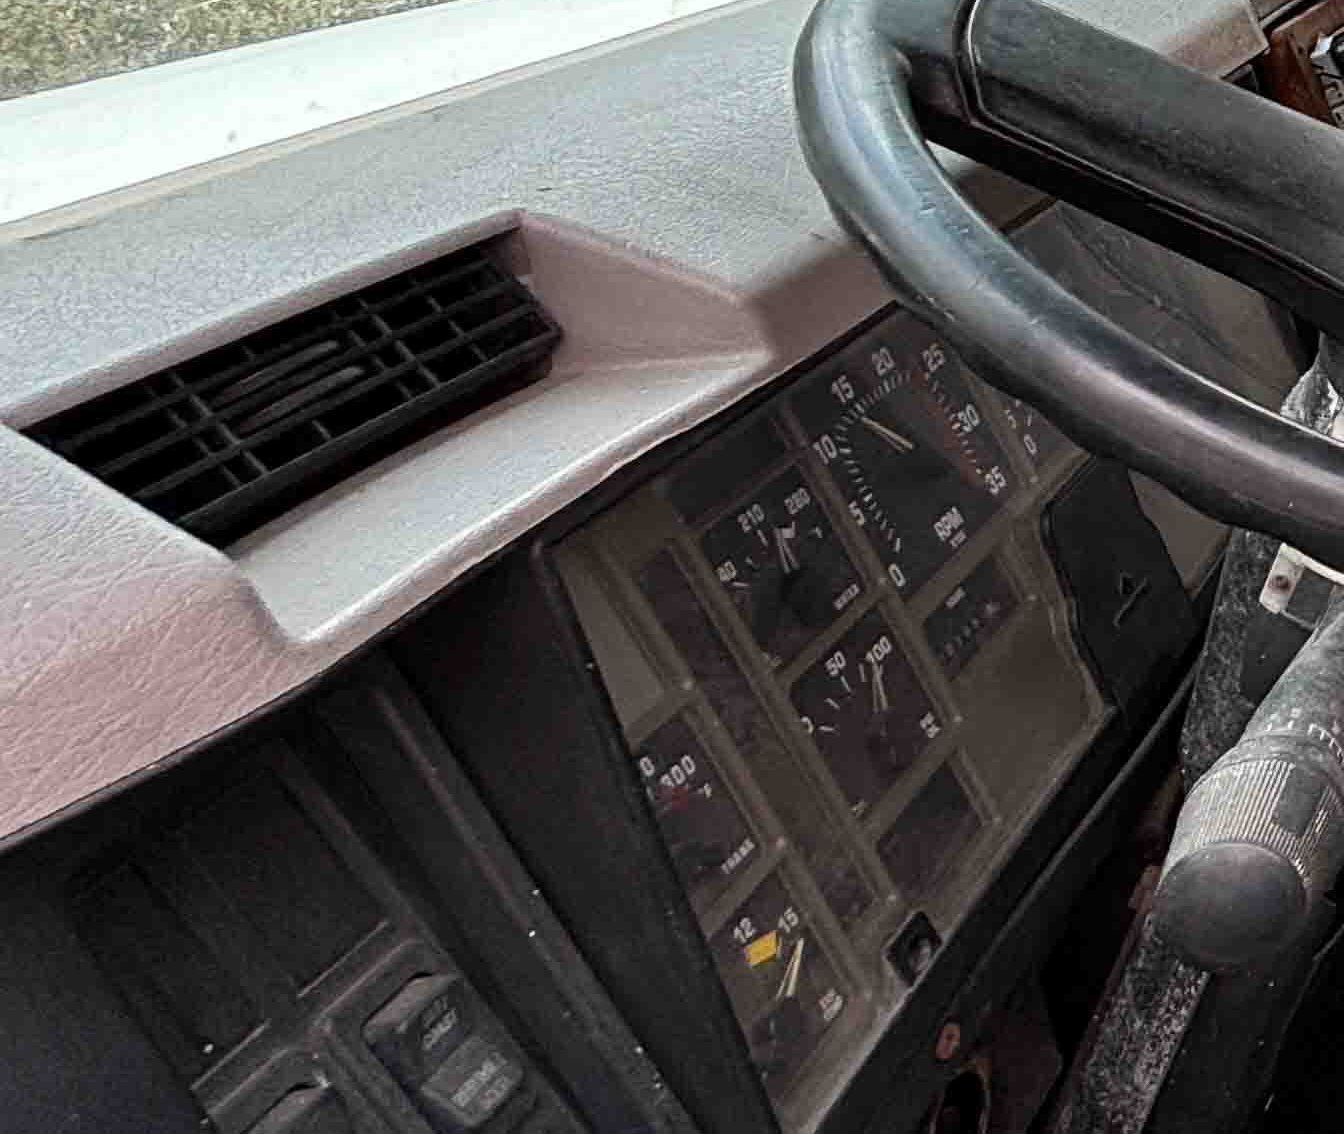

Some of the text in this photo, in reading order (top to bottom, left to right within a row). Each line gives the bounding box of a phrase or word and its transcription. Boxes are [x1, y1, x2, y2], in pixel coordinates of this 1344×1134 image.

[872, 347, 894, 376] 20
[922, 343, 944, 371] 25
[832, 375, 854, 402] 15
[959, 404, 979, 432] 30
[813, 433, 838, 465] 10
[1023, 433, 1037, 456] 0
[984, 466, 1007, 495] 35
[737, 503, 765, 532] 210
[849, 500, 865, 526] 5
[933, 505, 965, 541] RPM
[888, 563, 906, 586] 0
[825, 651, 846, 676] 50
[733, 917, 754, 944] 12
[778, 907, 799, 934] 15
